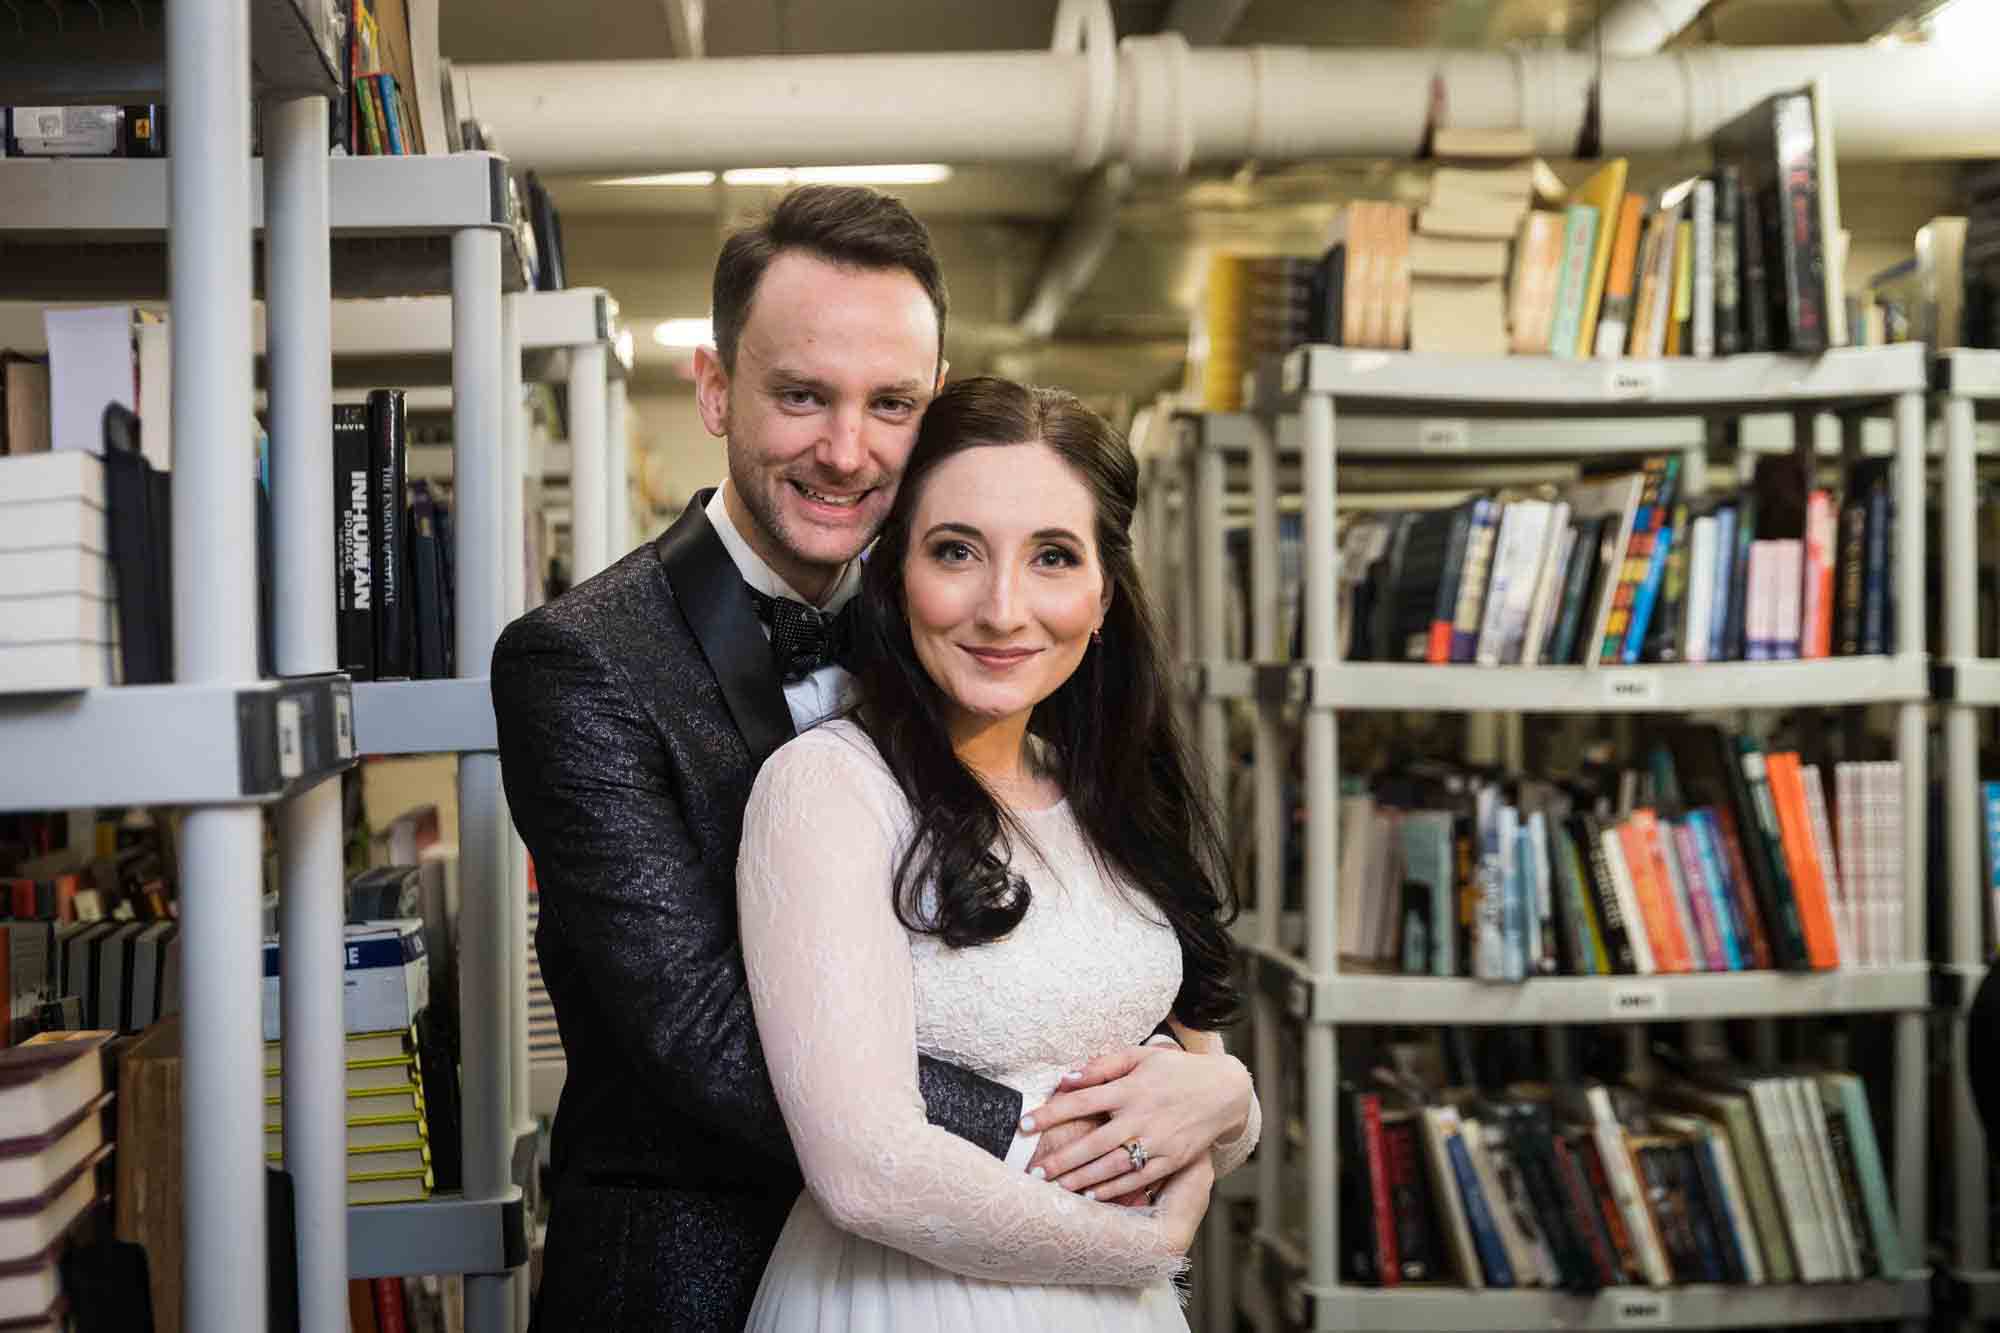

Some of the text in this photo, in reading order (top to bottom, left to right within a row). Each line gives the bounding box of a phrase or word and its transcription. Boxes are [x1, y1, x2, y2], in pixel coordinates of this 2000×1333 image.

[334, 423, 366, 431] DAVIS
[383, 465, 394, 491] THE
[343, 509, 354, 571] BONDAGE
[351, 471, 370, 609] INHUMAN
[383, 493, 394, 541] ENIGMA
